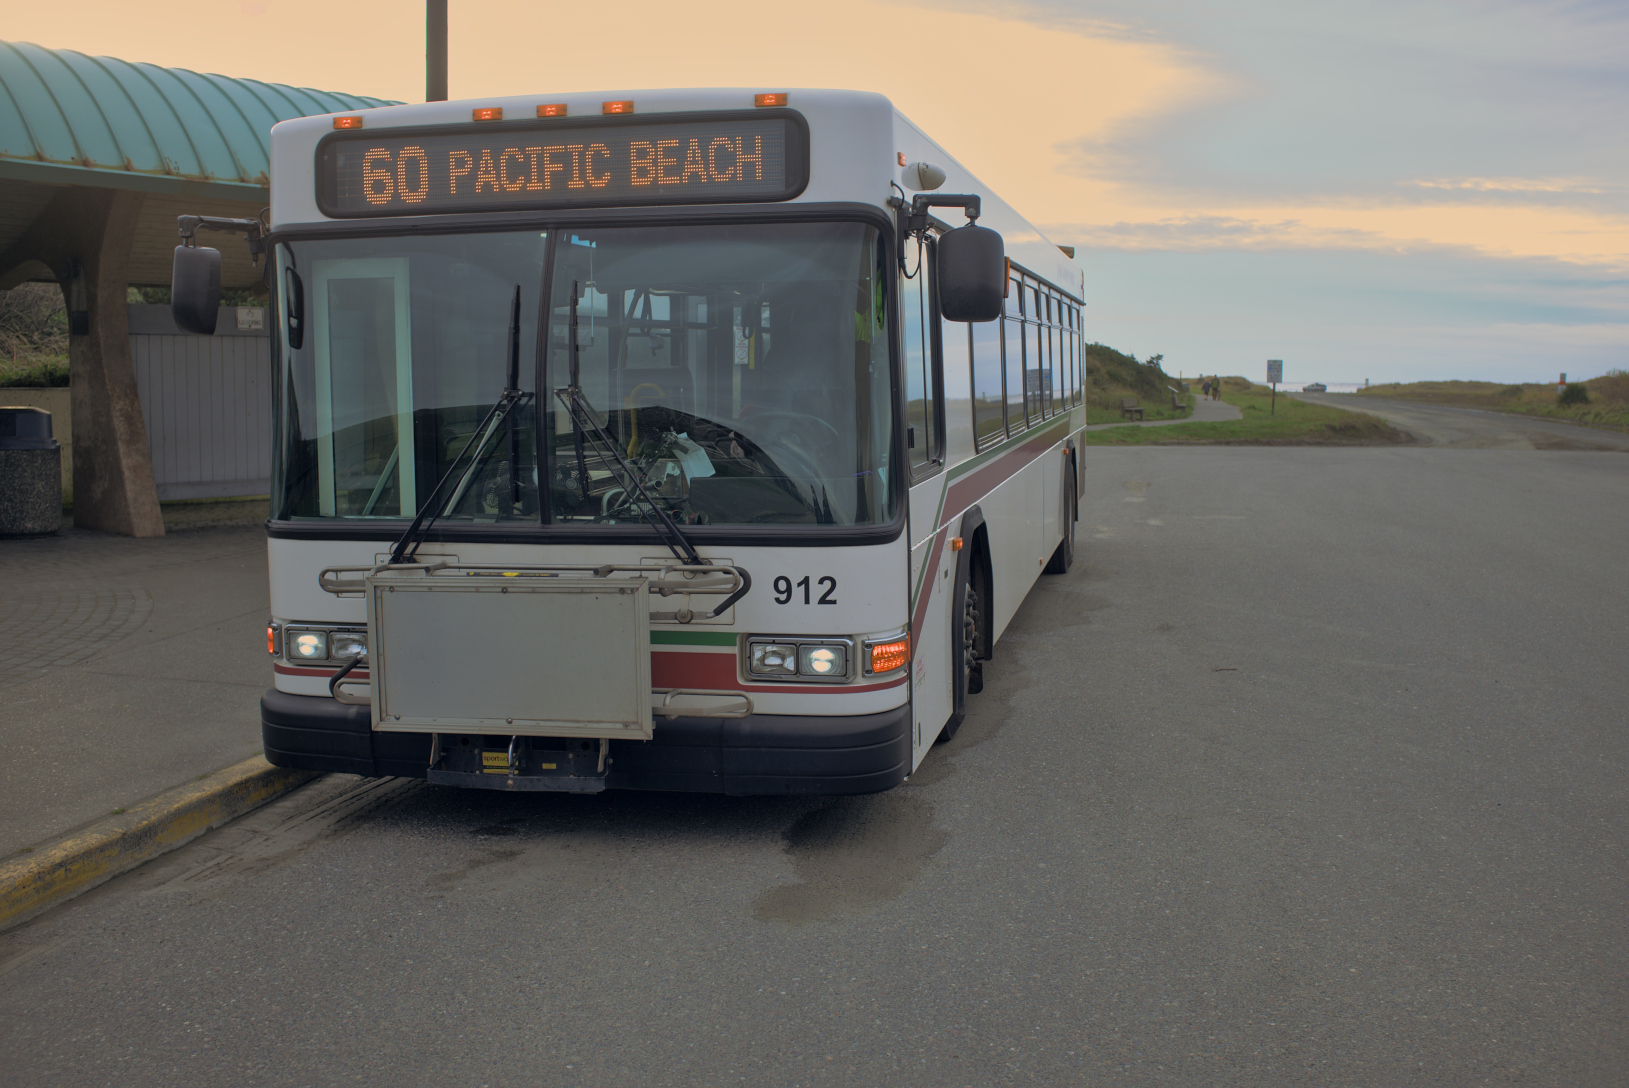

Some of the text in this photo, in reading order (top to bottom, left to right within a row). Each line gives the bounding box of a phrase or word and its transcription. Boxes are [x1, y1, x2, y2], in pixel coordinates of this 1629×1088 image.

[362, 135, 762, 205] 60 PACIFIC BEACH
[773, 575, 838, 605] 912
[483, 754, 509, 762] sportwo
